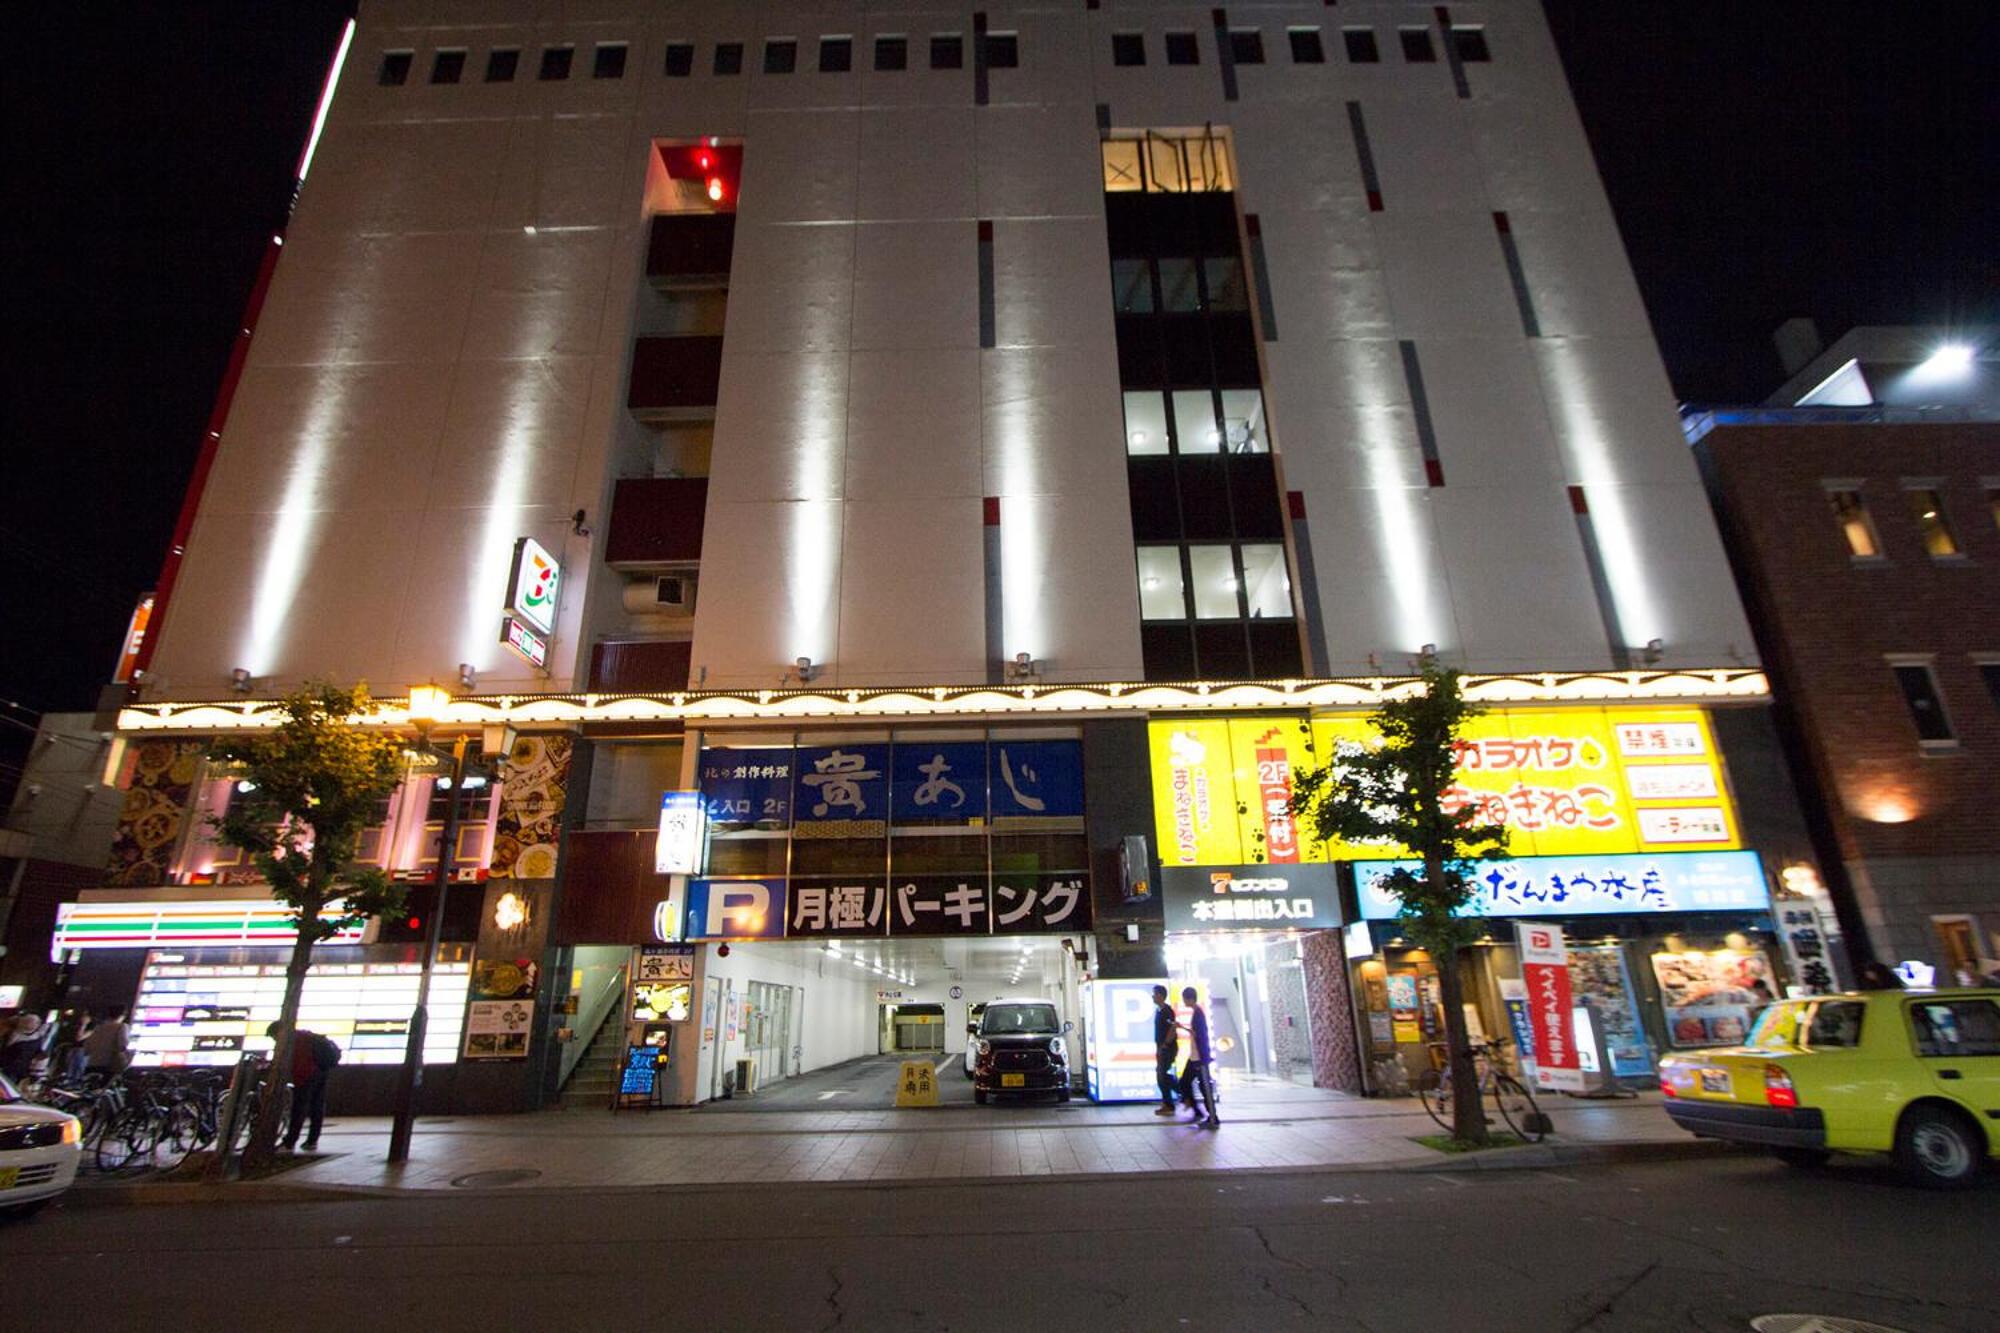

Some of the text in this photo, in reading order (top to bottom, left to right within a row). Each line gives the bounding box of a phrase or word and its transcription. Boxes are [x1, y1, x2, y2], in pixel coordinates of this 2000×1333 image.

[1451, 738, 1574, 769] カラオケ
[704, 766, 789, 780] 北の創作料理
[801, 746, 1045, 817] 貴あじ
[720, 798, 787, 814] 入口 2F
[1173, 768, 1196, 862] まねきねこ
[1486, 864, 1671, 908] だんまや水産
[705, 879, 1083, 934] P 月極パーキング
[642, 956, 691, 978] 貴あじ
